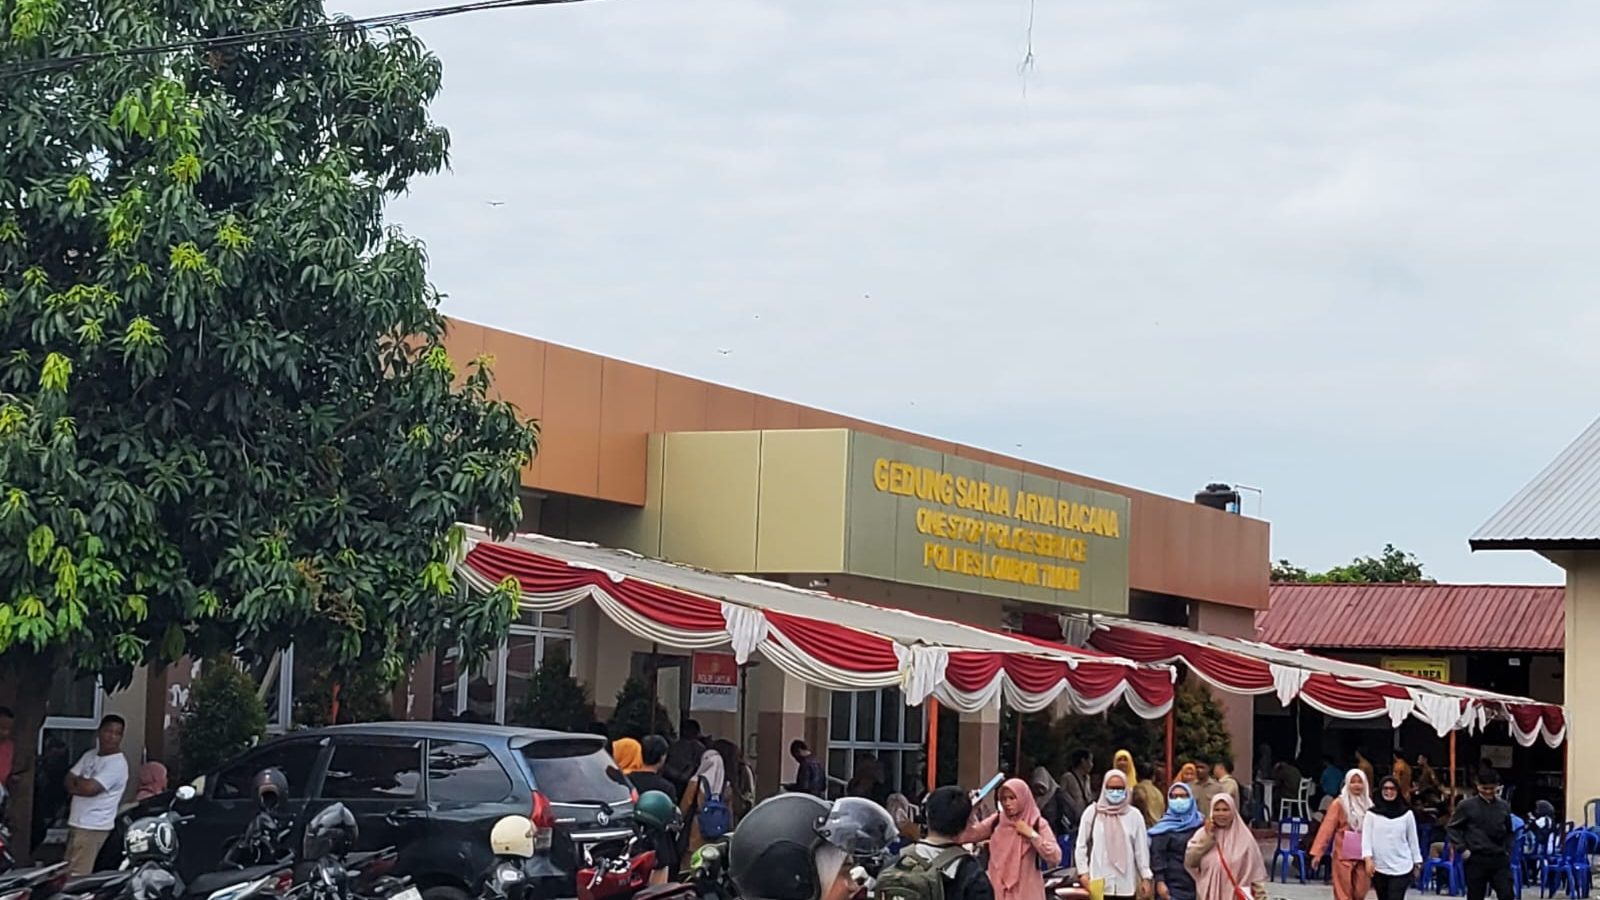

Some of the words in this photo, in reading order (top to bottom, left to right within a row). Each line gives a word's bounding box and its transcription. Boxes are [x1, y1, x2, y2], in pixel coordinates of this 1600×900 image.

[873, 458, 954, 505] GEDUNG
[956, 475, 1009, 517] SARJA
[1014, 490, 1057, 526] ARYA
[1058, 499, 1119, 537] RACANA
[916, 507, 946, 537] ONE
[946, 514, 984, 543] STOP
[985, 522, 1034, 554] POLICE
[1034, 531, 1087, 562] SERVICE
[924, 541, 982, 576] POLRES
[982, 553, 1040, 586] LOMBOK
[1040, 564, 1080, 591] TIMUR
